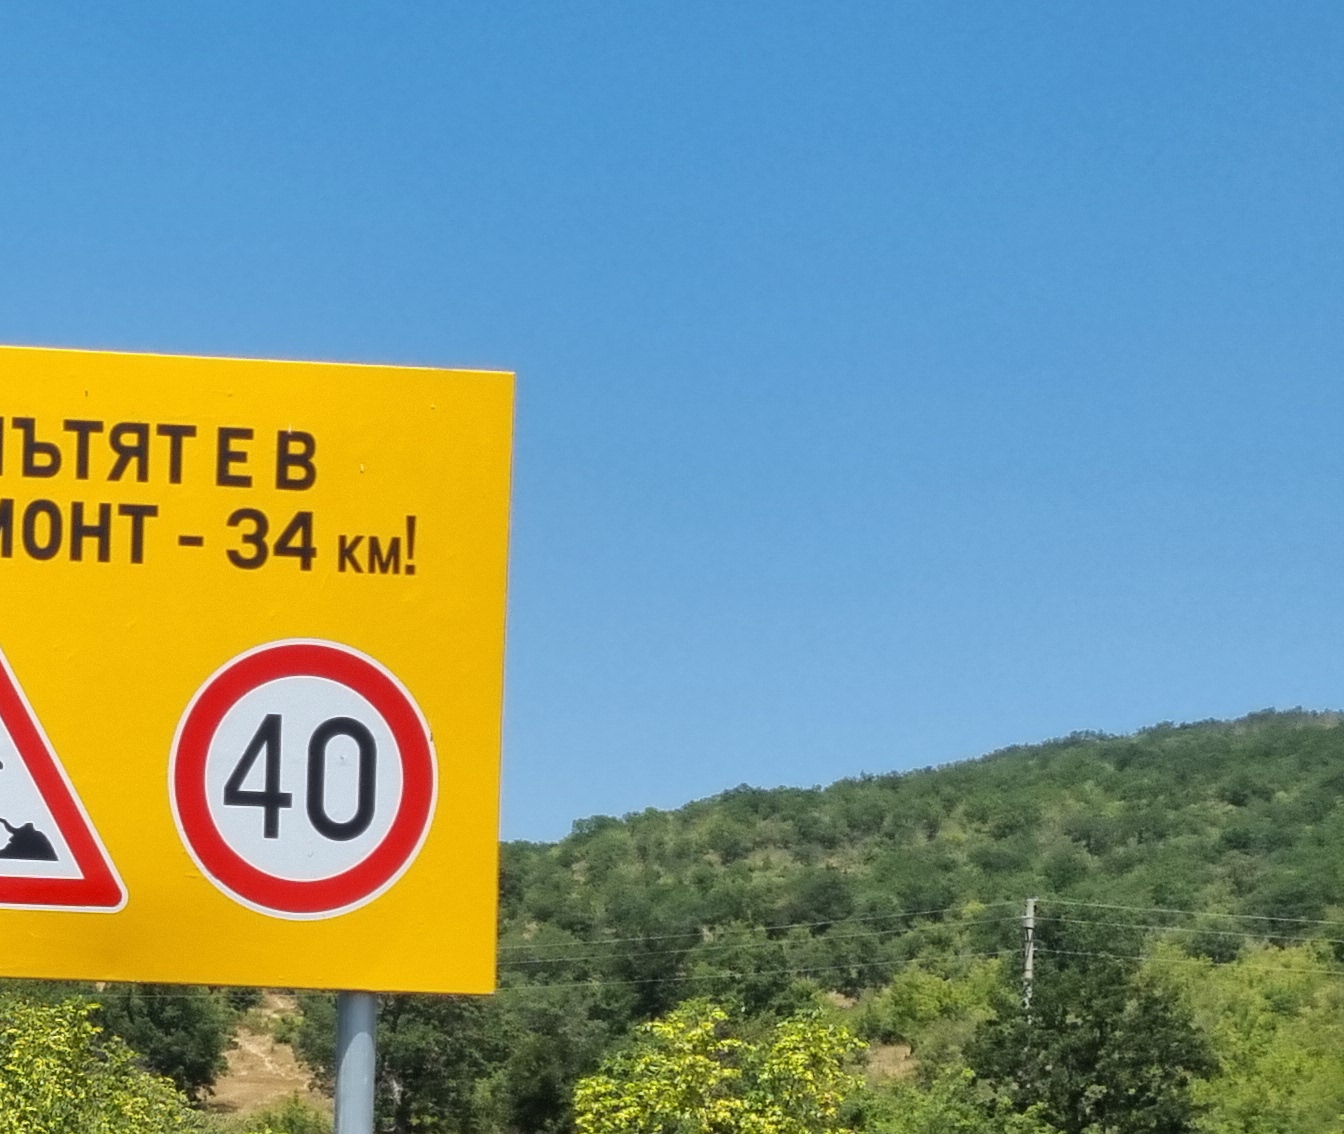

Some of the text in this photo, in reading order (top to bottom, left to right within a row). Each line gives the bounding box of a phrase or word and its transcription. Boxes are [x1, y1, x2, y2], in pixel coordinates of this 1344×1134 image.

[215, 425, 255, 489] Е
[275, 428, 319, 492] В
[177, 534, 205, 549] -
[225, 507, 318, 573] 34
[223, 712, 378, 842] 40
